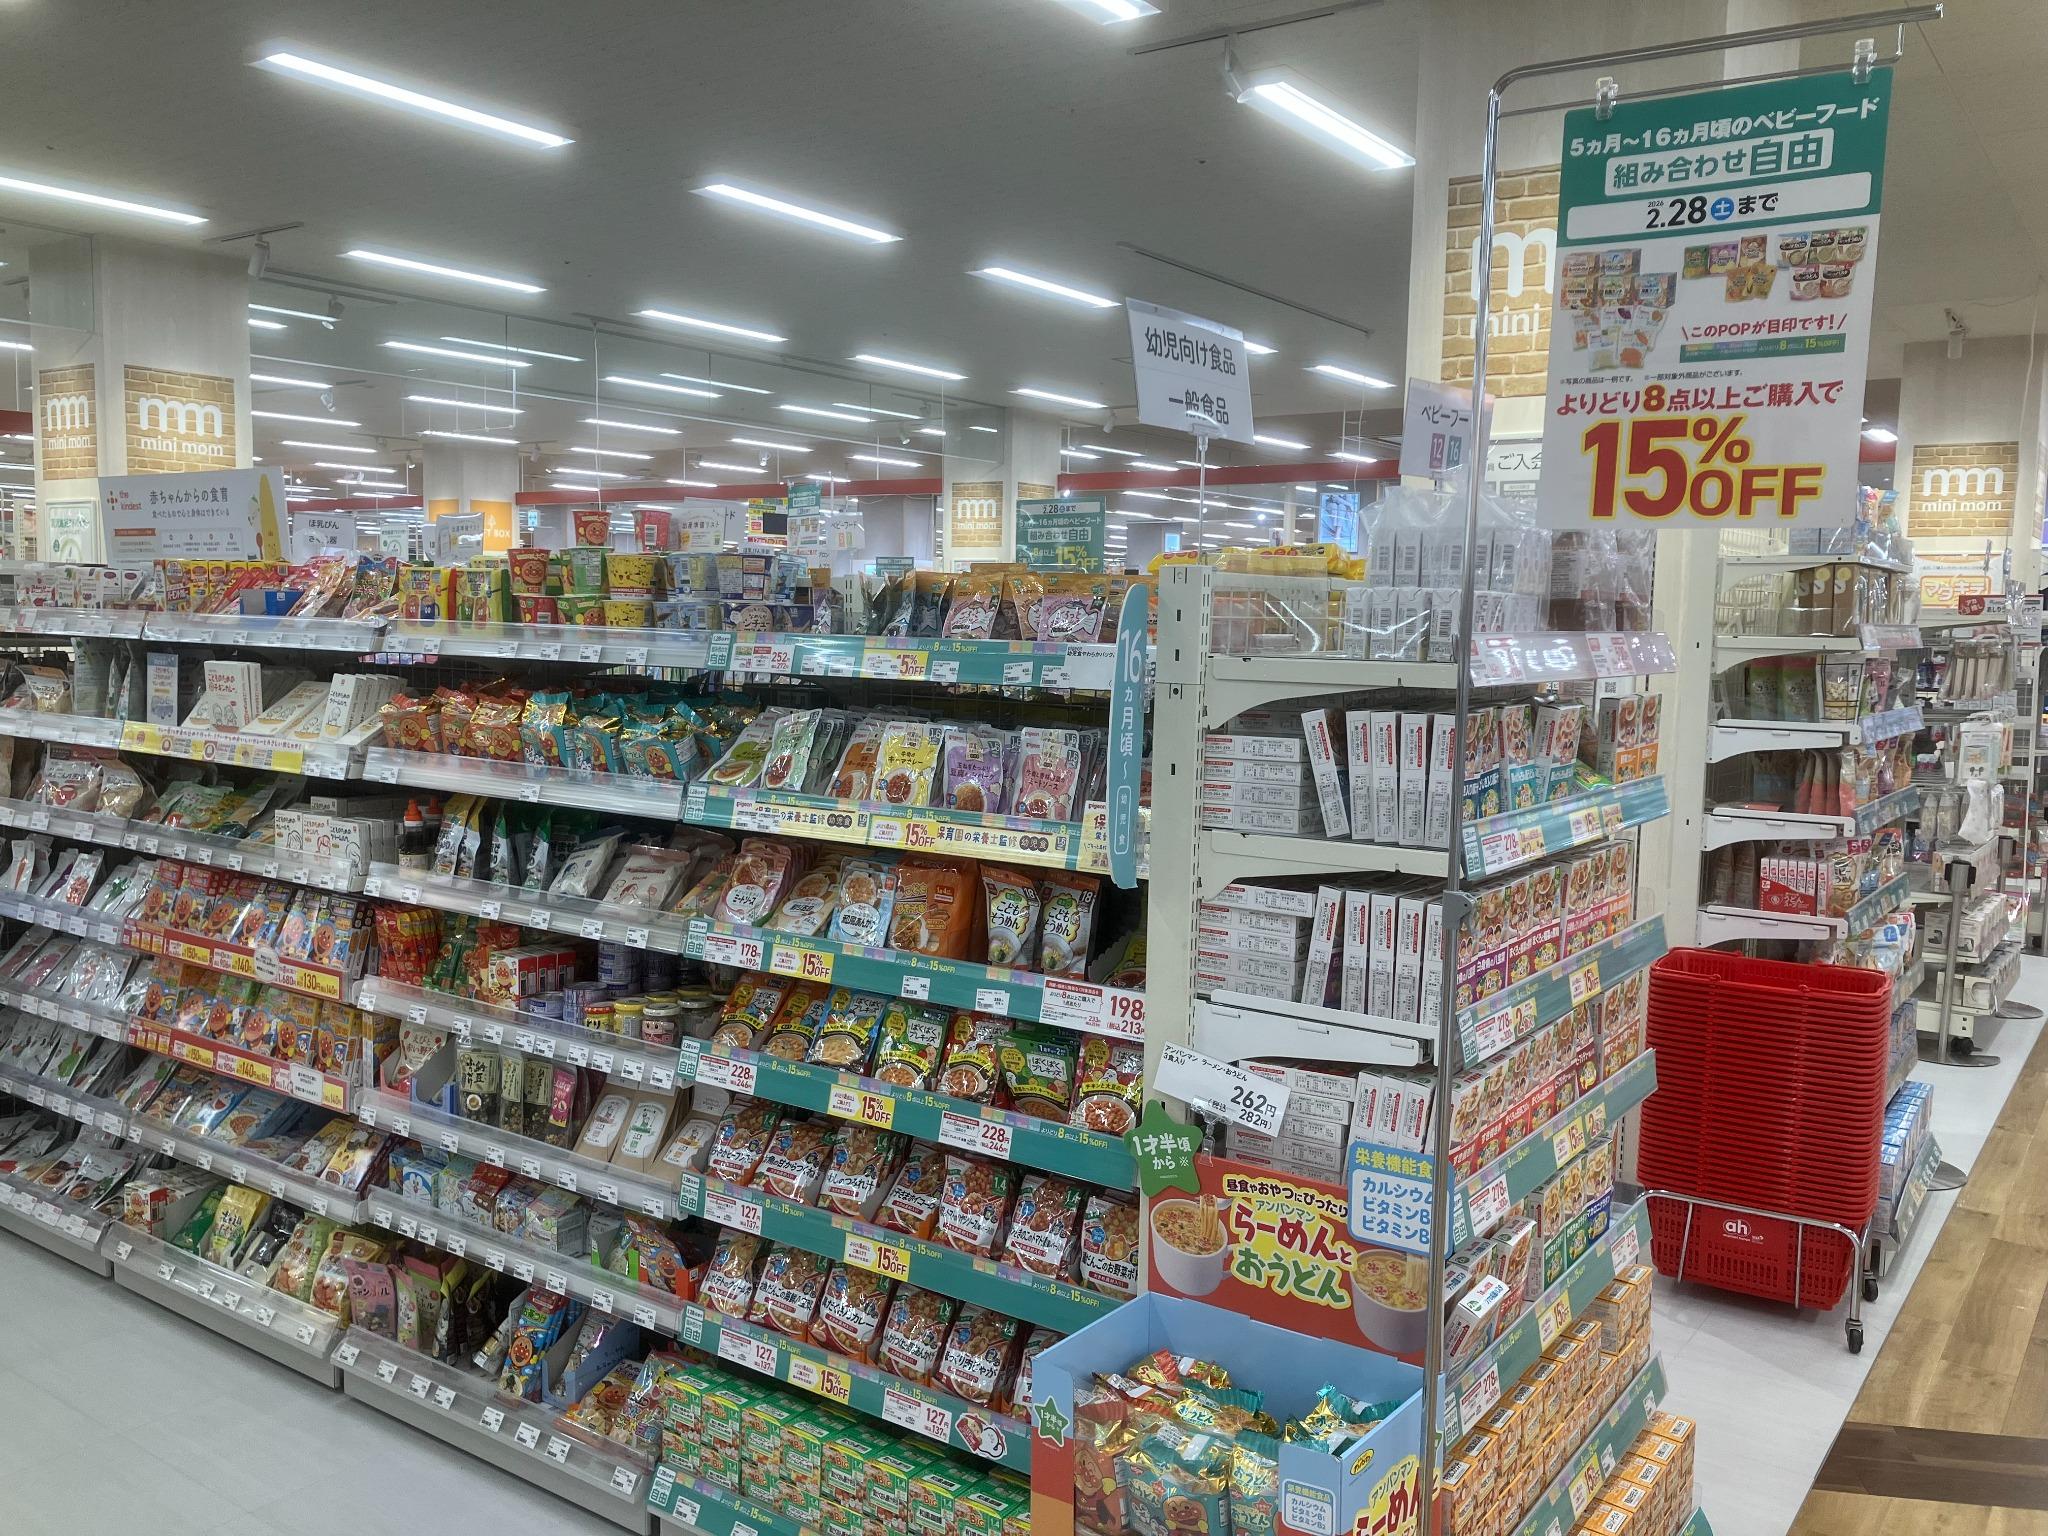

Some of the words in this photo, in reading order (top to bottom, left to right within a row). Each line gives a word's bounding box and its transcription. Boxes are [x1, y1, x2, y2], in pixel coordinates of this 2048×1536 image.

[1614, 134, 1823, 188] 組み合わせ自由
[1145, 326, 1236, 376] 幼児向け食品
[1169, 389, 1229, 425] 一般食品
[1556, 379, 1844, 417] よりどり8点以上ご購入で
[48, 436, 66, 450] mini
[68, 435, 90, 448] mom
[141, 436, 177, 452] mini
[182, 441, 223, 456] mom
[150, 487, 229, 505] 赤ちゃんからの食育
[1922, 499, 1956, 512] mini
[1961, 500, 2001, 511] mom
[308, 519, 340, 530] ほ乳びん
[1030, 528, 1089, 541] 組み合わせ自由
[1118, 793, 1127, 846] 幼児食
[937, 826, 1018, 847] 保育園の栄養士監修
[1019, 835, 1049, 852] 幼児食
[996, 900, 1020, 916] こども
[1048, 907, 1070, 923] こども
[990, 913, 1020, 930] そうめん
[741, 943, 761, 958] 178円
[1164, 1052, 1186, 1066] 3食入り
[1164, 1045, 1199, 1062] アンパンマン
[1201, 1058, 1248, 1081] ラーメン・おうどん
[731, 1064, 754, 1081] 228円
[1230, 1085, 1277, 1118] 262円
[982, 1124, 1010, 1144] 228円
[1133, 1132, 1191, 1156] 1才半頃
[1153, 1156, 1176, 1169] から
[1227, 1182, 1349, 1218] 昼食やおやつにぴったり
[741, 1204, 760, 1221] 127円
[1256, 1200, 1316, 1222] アンパンマン
[1725, 1219, 1748, 1235] ah
[1236, 1247, 1346, 1303] おうどん
[926, 1407, 949, 1428] 127円
[1371, 1460, 1414, 1509] アンパンマン
[1292, 1498, 1326, 1514] カルシウム
